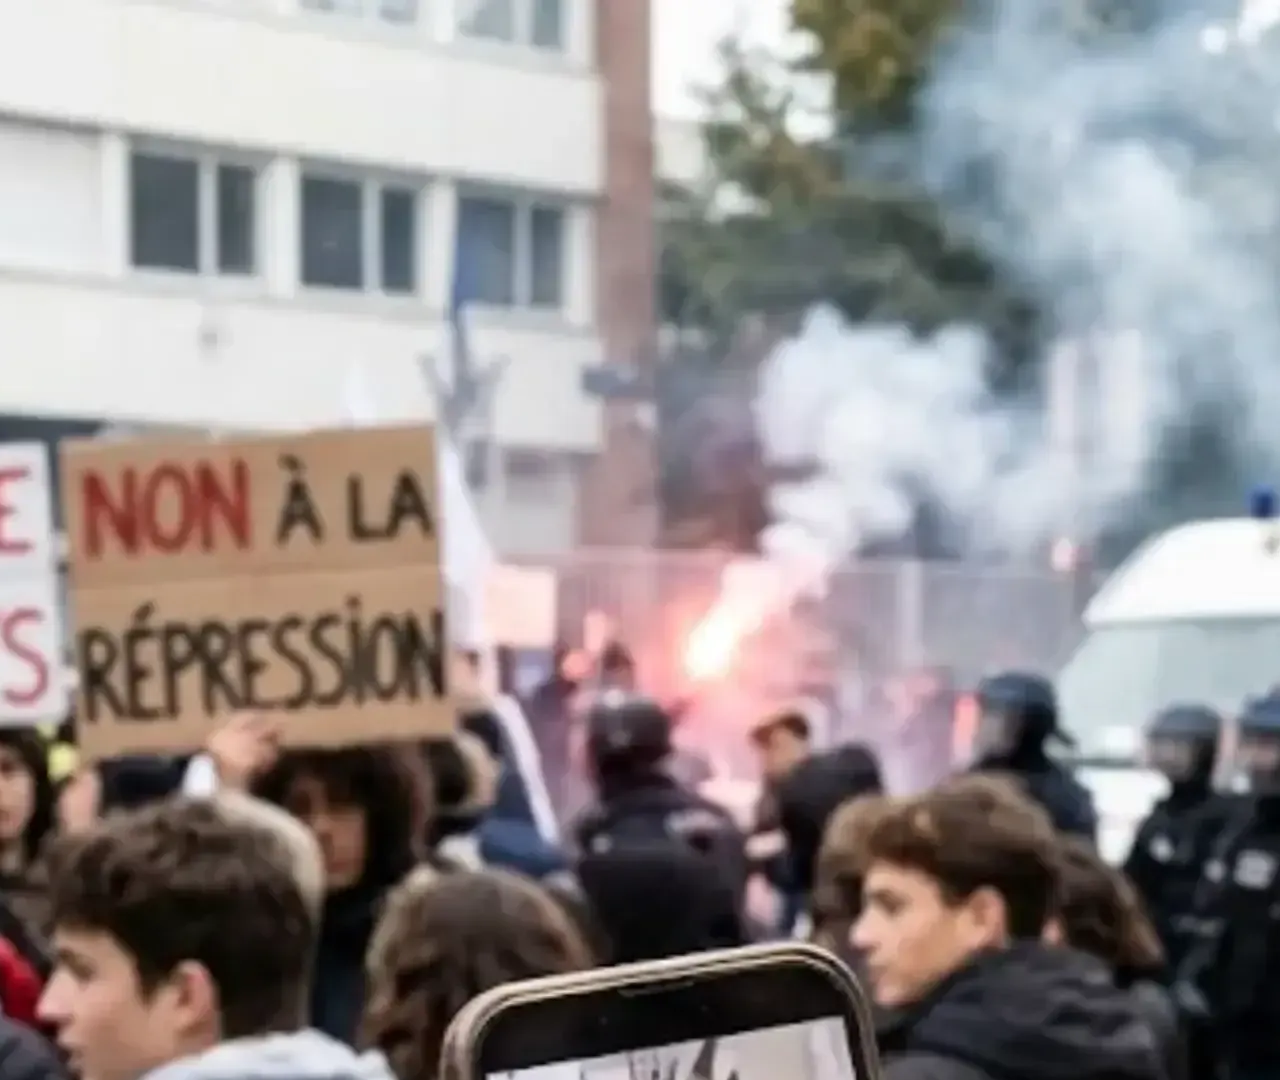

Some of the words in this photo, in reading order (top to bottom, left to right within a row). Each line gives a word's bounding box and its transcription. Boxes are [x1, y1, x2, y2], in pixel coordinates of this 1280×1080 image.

[81, 459, 252, 560] NON
[276, 454, 325, 546] À
[348, 466, 435, 543] LA
[78, 596, 447, 722] RÉPRESSION
